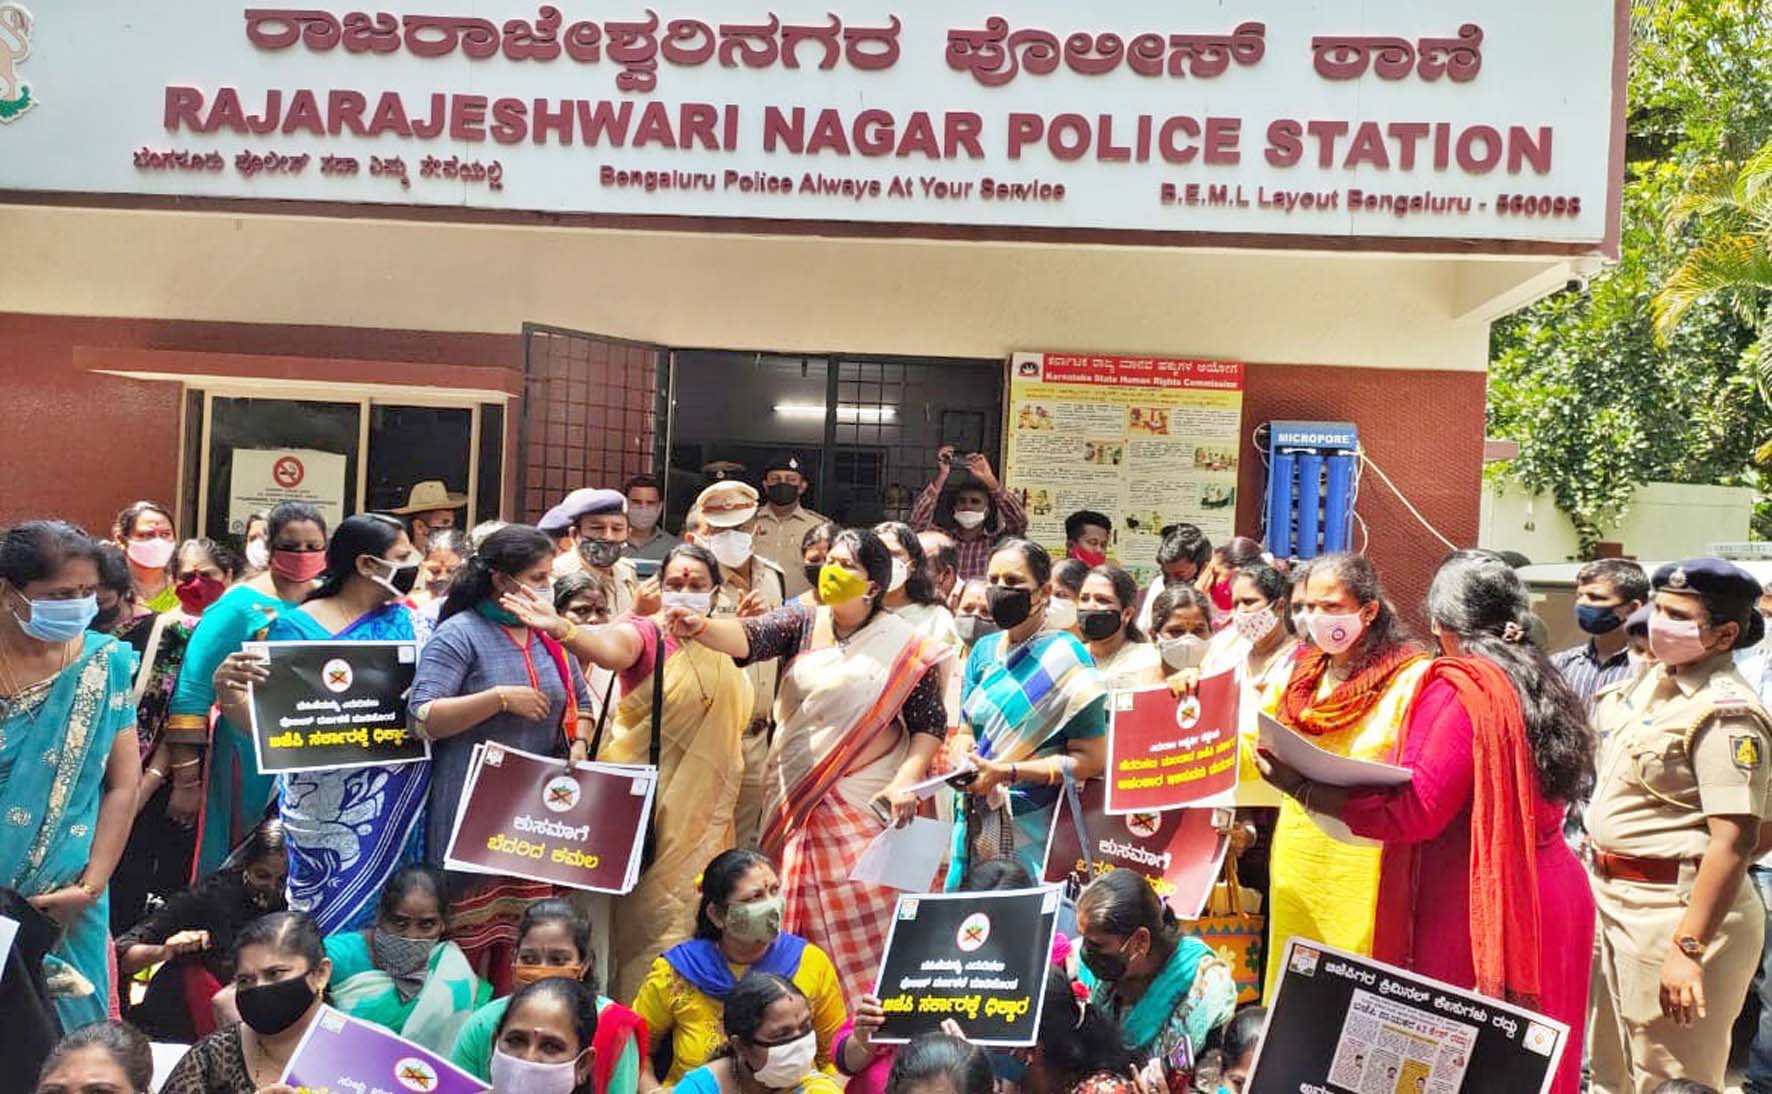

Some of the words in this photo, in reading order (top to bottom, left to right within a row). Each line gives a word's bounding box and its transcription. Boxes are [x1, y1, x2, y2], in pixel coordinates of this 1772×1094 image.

[243, 5, 902, 94] ರಾಜರಾಜೇಶ್ವರಿನಗರ
[945, 16, 1266, 89] ಪೊಲೀಸ್
[1311, 23, 1484, 84] ಠಾಣೆ
[163, 83, 739, 154] RAJARAJESHWARI
[763, 105, 985, 161] NAGAR
[1007, 112, 1242, 166] POLICE
[1263, 118, 1553, 176] STATION
[599, 165, 716, 193] Bengaluru
[723, 169, 793, 194] Police
[798, 172, 881, 202] Always
[887, 175, 914, 198] At
[919, 176, 974, 200] Your
[979, 177, 1066, 201] Service
[1160, 182, 1249, 208] B.E.M.L
[1257, 186, 1339, 214] Layout
[1346, 189, 1472, 217] Bengaluru
[1045, 372, 1092, 382] Karnataka
[1094, 374, 1118, 383] State
[1119, 375, 1151, 385] Human
[1153, 376, 1182, 388] Rights
[1183, 378, 1238, 389] Commission
[1278, 433, 1350, 445] MICROPORE
